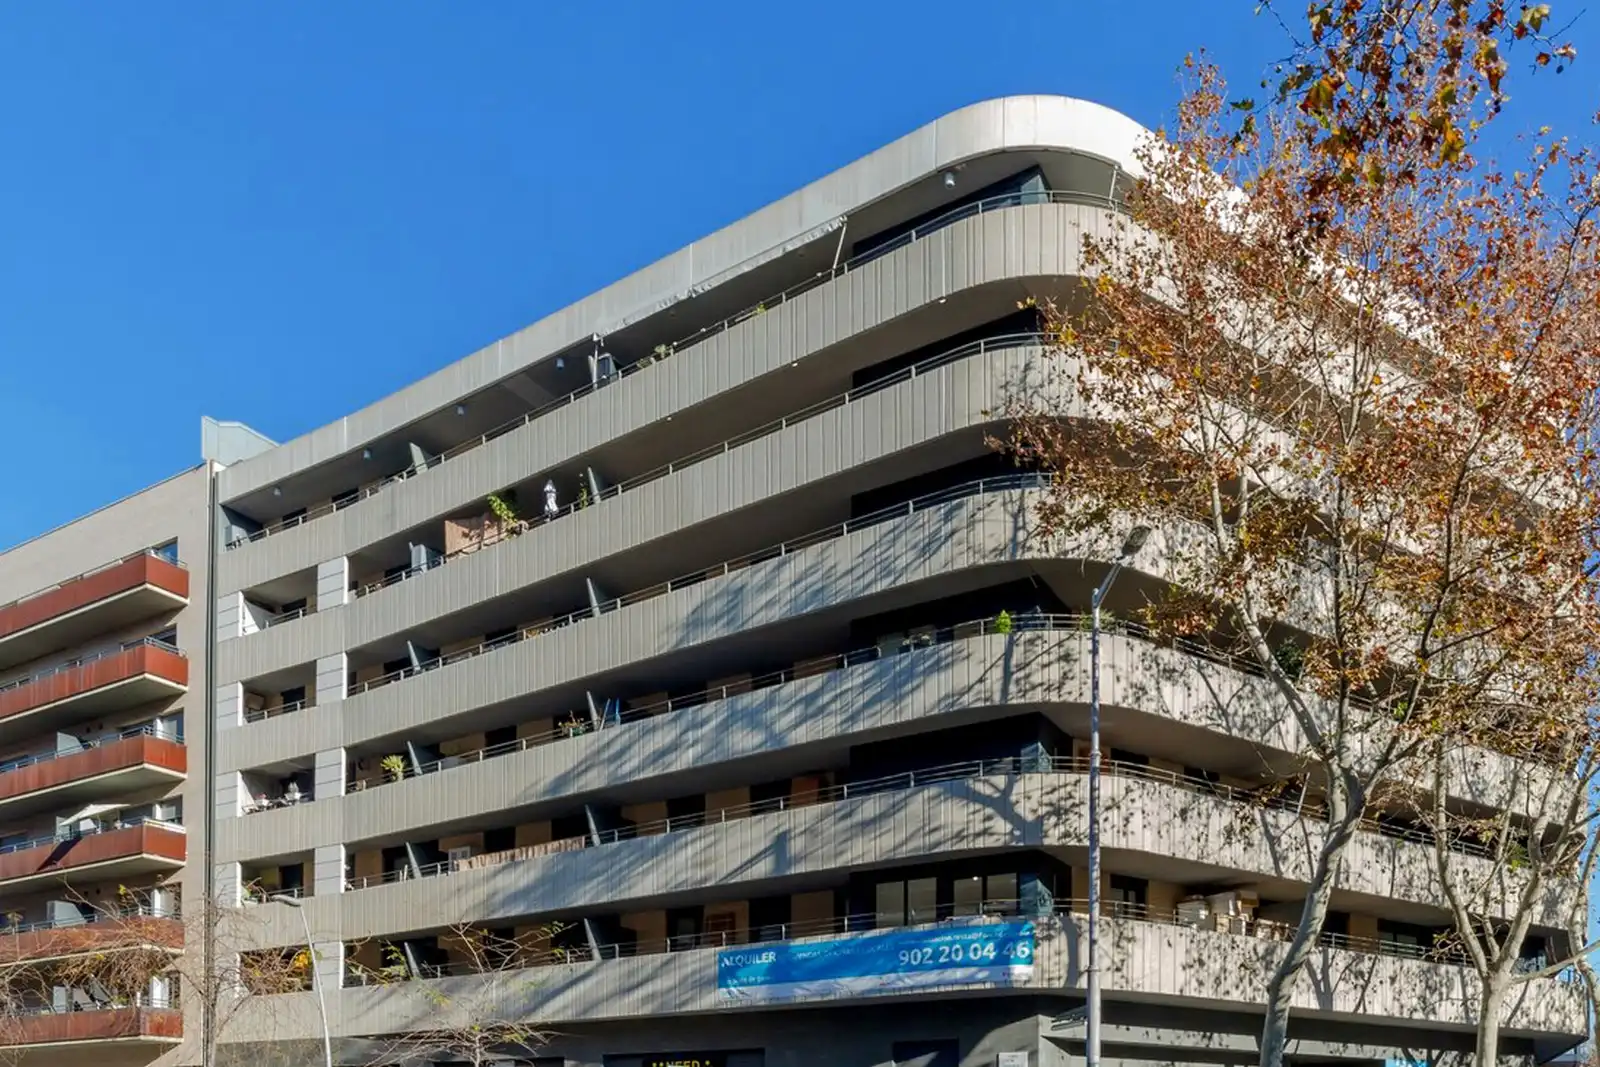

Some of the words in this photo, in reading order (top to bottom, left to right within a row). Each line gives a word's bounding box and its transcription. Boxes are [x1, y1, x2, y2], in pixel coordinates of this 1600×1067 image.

[720, 951, 776, 967] ALQUILER
[898, 947, 933, 966] 902
[938, 943, 964, 963] 20
[968, 941, 996, 960] 04
[1002, 940, 1030, 959] 46
